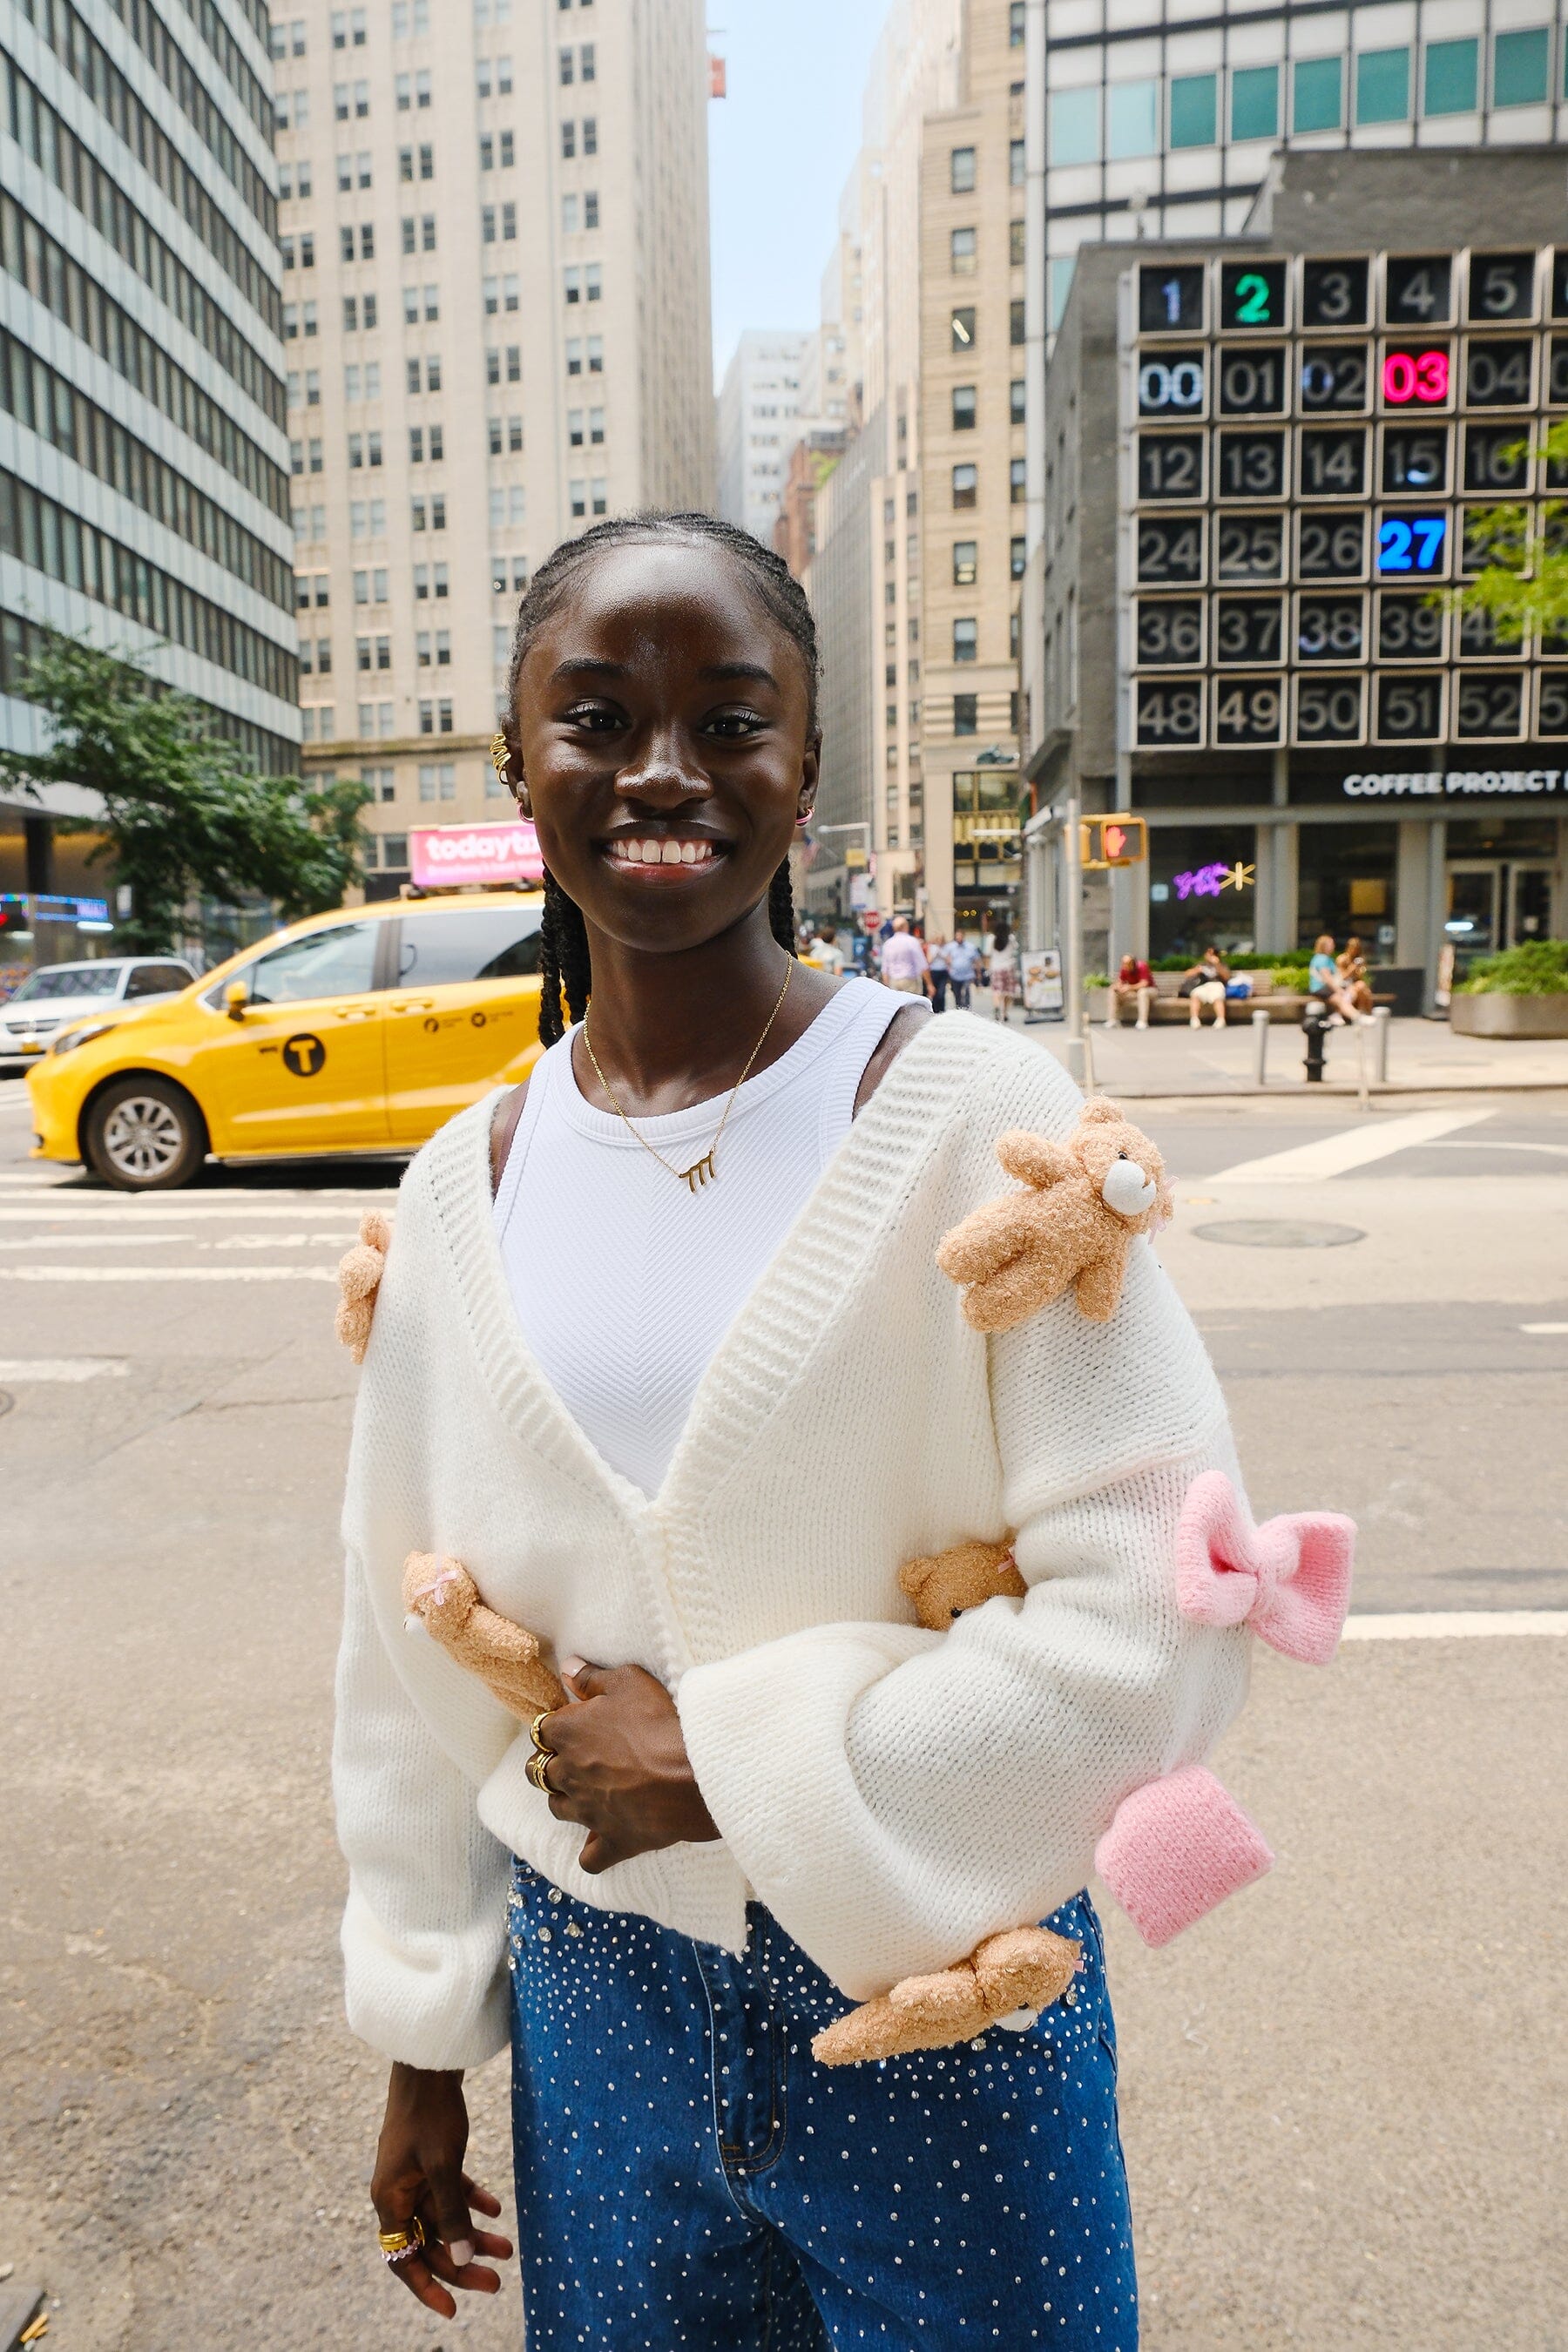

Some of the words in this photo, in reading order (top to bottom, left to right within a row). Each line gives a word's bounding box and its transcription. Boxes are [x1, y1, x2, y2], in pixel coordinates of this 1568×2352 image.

[1161, 278, 1181, 323] 1
[1235, 274, 1270, 323] 2
[1318, 272, 1351, 319] 3
[1401, 269, 1436, 315] 4
[1483, 266, 1517, 314] 5
[1139, 362, 1203, 408] 00
[1224, 357, 1275, 406] 01
[1301, 356, 1366, 403] 02
[1382, 351, 1450, 403] 03
[1469, 353, 1530, 398] 04
[1551, 351, 1568, 396] 0
[1145, 444, 1195, 490] 12
[1227, 443, 1276, 490] 13
[1309, 440, 1357, 488] 14
[1389, 439, 1442, 484] 15
[1471, 437, 1520, 483] 16
[1139, 529, 1200, 574] 24
[1220, 527, 1281, 571] 25
[1301, 524, 1362, 570] 26
[1378, 519, 1446, 570] 27
[1139, 611, 1200, 654] 36
[1220, 608, 1281, 652] 37
[1299, 607, 1362, 652] 38
[1379, 605, 1439, 650] 39
[1139, 692, 1200, 736] 48
[1220, 689, 1281, 734] 49
[1299, 687, 1359, 733] 50
[1385, 686, 1433, 731] 51
[1459, 685, 1520, 729] 52
[1540, 684, 1568, 727] 5
[1343, 772, 1443, 795] COFFEE
[1446, 769, 1561, 793] PROJECT
[288, 1038, 317, 1074] T
